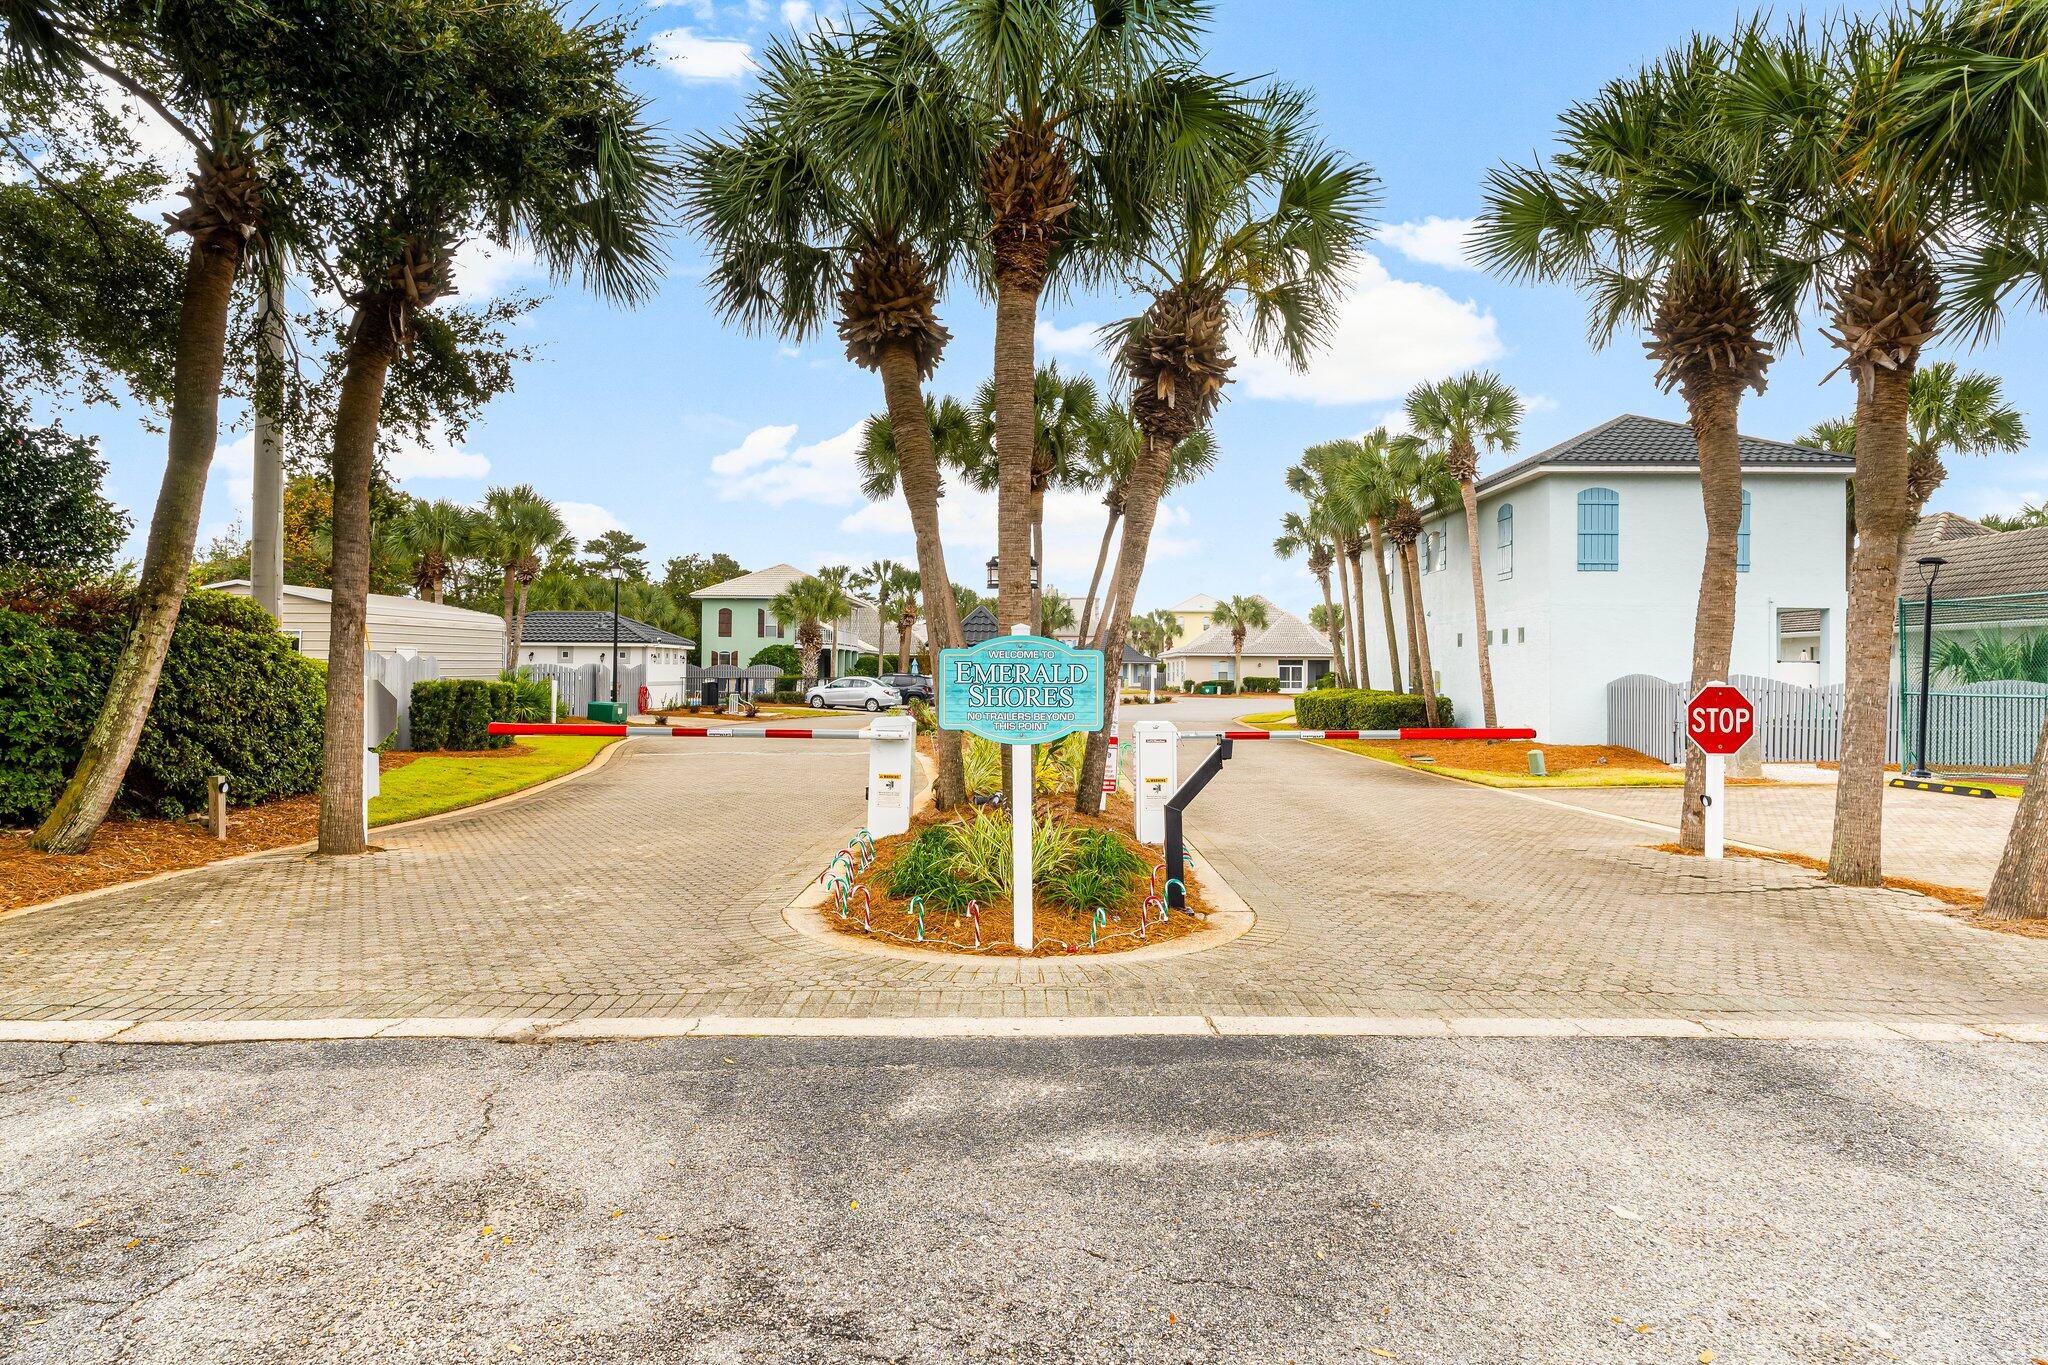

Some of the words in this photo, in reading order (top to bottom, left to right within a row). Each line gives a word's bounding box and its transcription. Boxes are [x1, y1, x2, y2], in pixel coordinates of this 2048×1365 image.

[989, 651, 1039, 659] WELCOME
[1041, 651, 1055, 659] TO
[954, 661, 1089, 684] EMERALD
[968, 685, 1074, 708] SHORES
[967, 712, 982, 721] NO
[985, 712, 1031, 721] TRAILERS
[1033, 712, 1075, 721] BEYOND
[1691, 707, 1750, 733] STOP
[993, 722, 1016, 730] THIS
[1018, 722, 1049, 730] POINT
